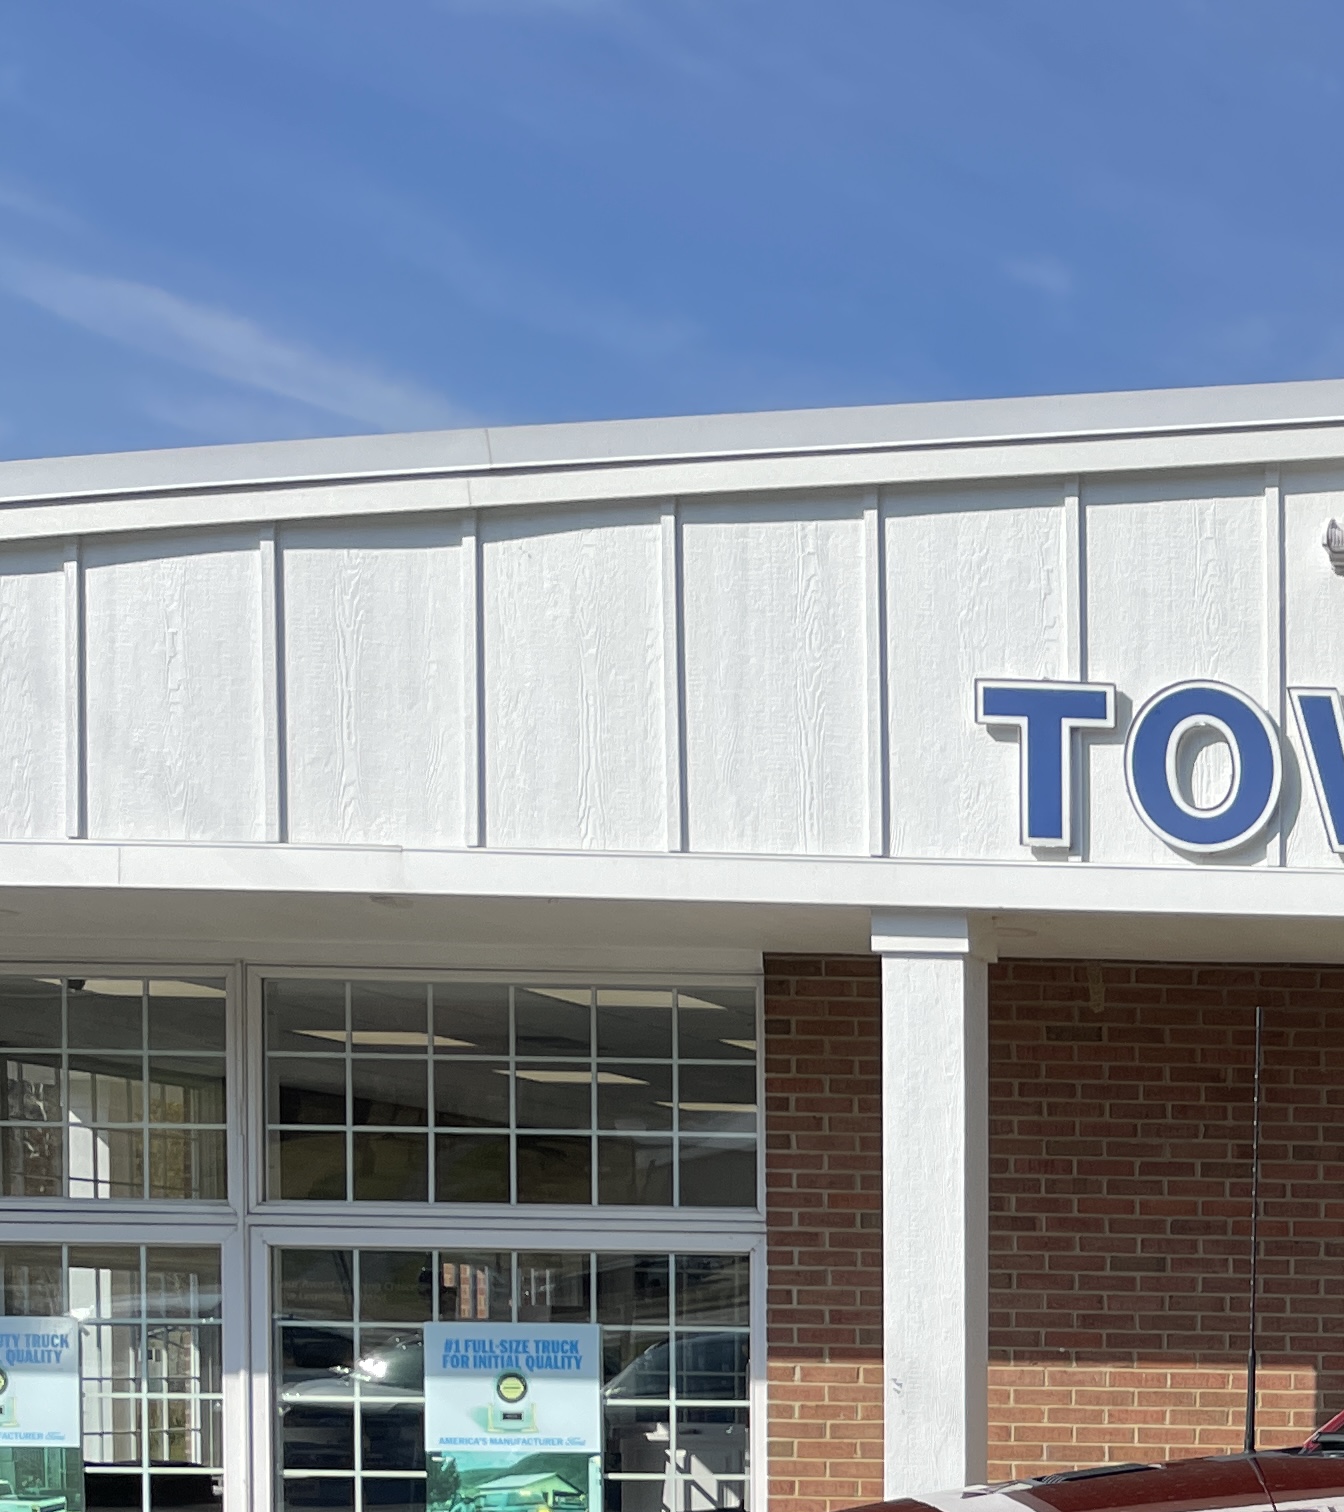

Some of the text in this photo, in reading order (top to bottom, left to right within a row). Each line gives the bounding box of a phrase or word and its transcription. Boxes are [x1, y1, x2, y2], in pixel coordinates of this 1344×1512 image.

[25, 1334, 69, 1349] TRUCK
[444, 1338, 580, 1354] #1 FULL-SIZE TRUCK
[6, 1350, 62, 1366] QUALITY
[442, 1354, 583, 1372] FOR INITIAL QUALITY
